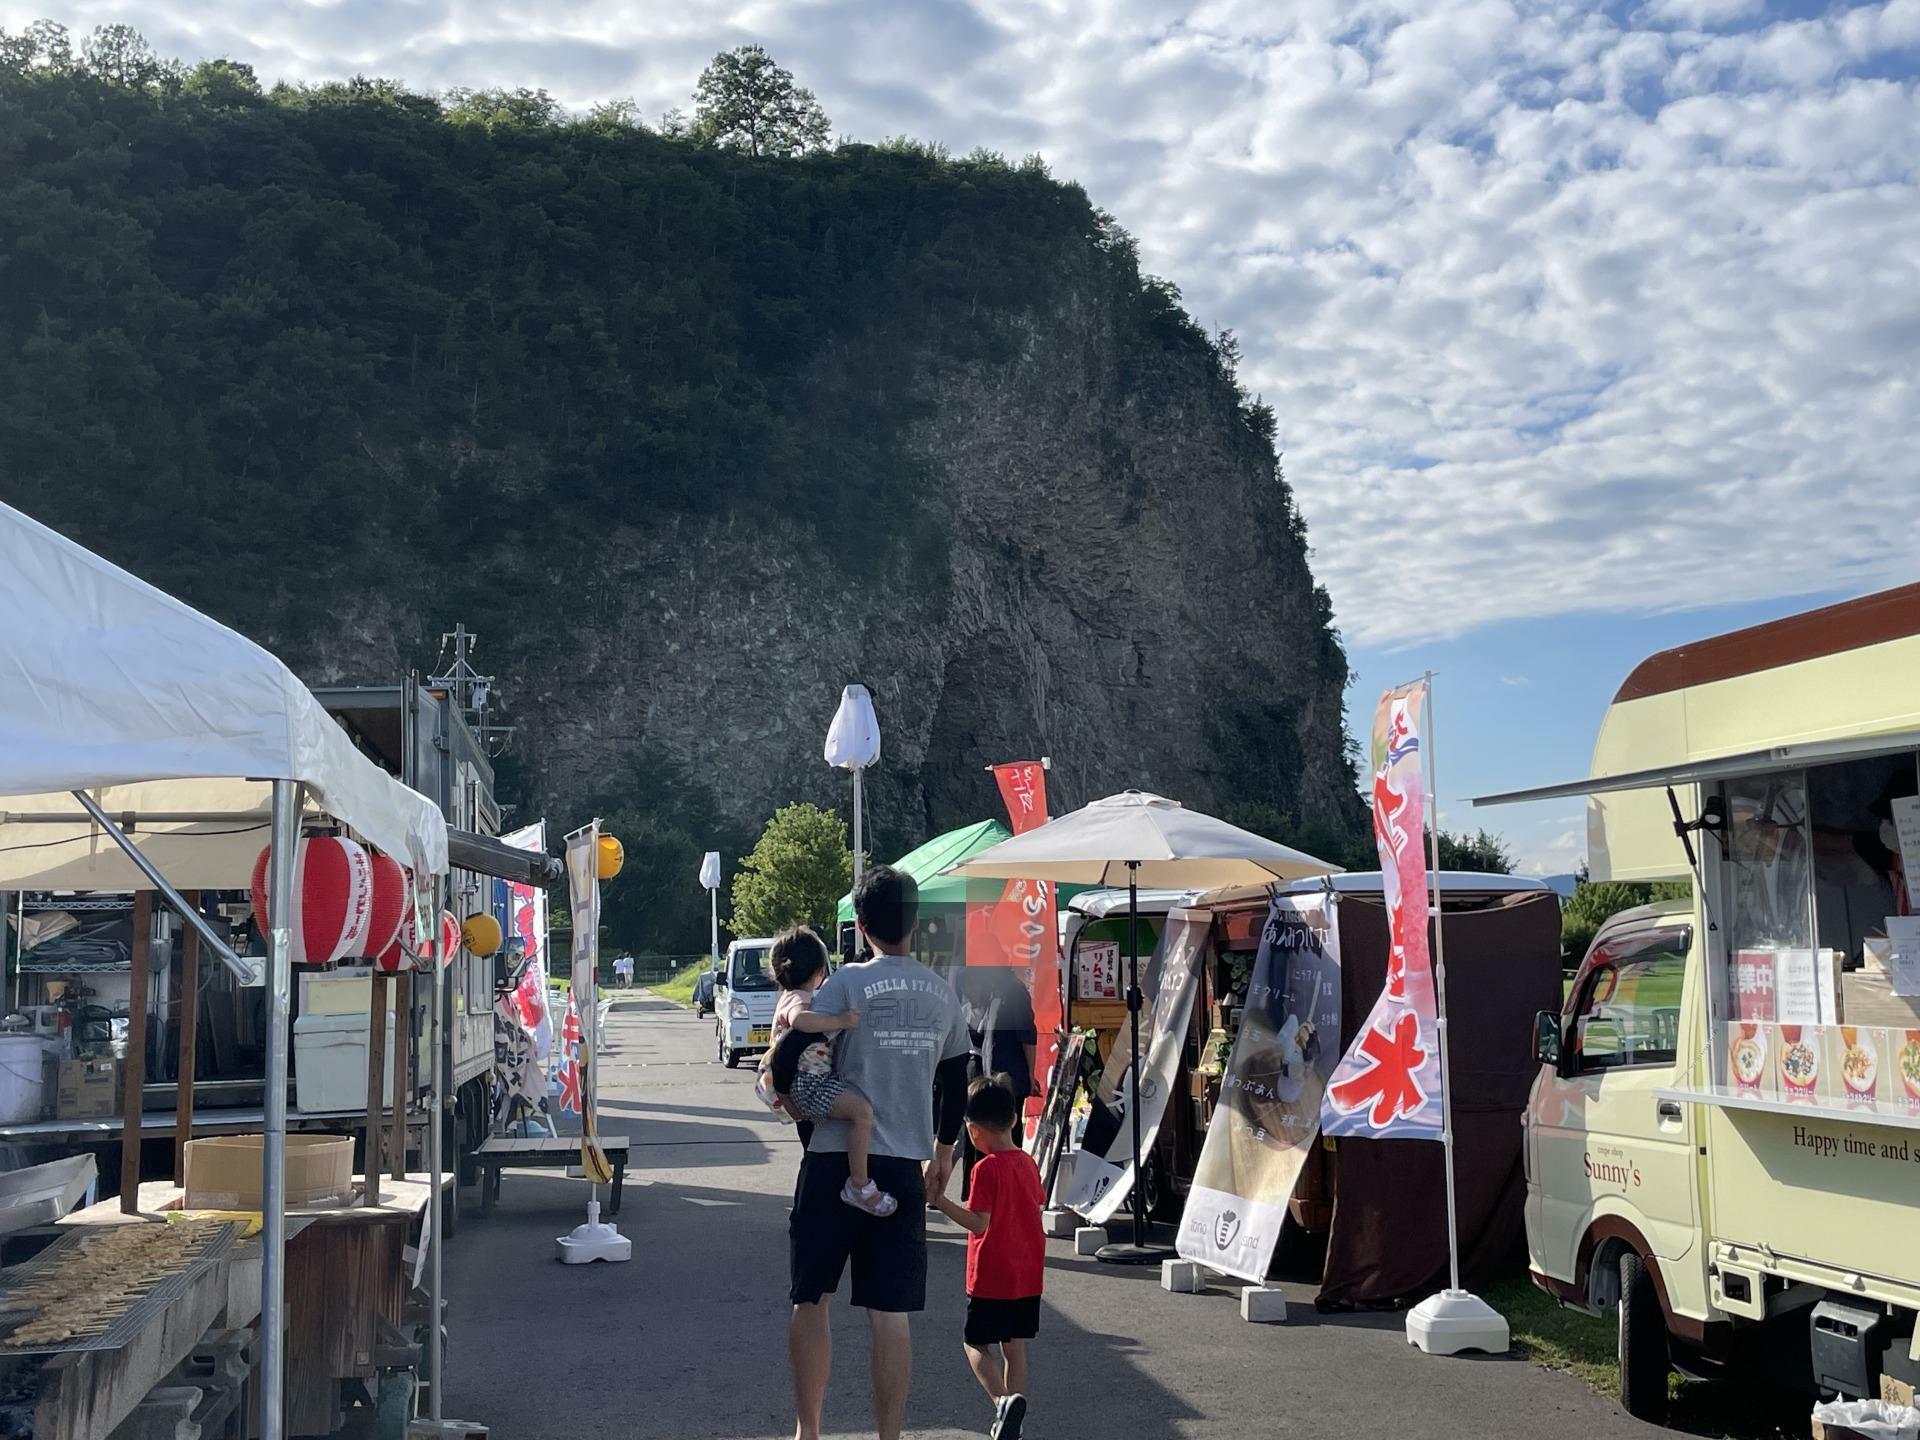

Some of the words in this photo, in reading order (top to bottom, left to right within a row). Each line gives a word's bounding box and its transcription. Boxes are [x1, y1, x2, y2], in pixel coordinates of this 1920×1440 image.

[863, 979, 908, 999] BIELLA
[1793, 1126, 1840, 1157] Happy
[1844, 1134, 1876, 1157] time
[1881, 1140, 1909, 1161] and
[1584, 1152, 1641, 1193] Sunny's
[1884, 1382, 1905, 1405] 紙
